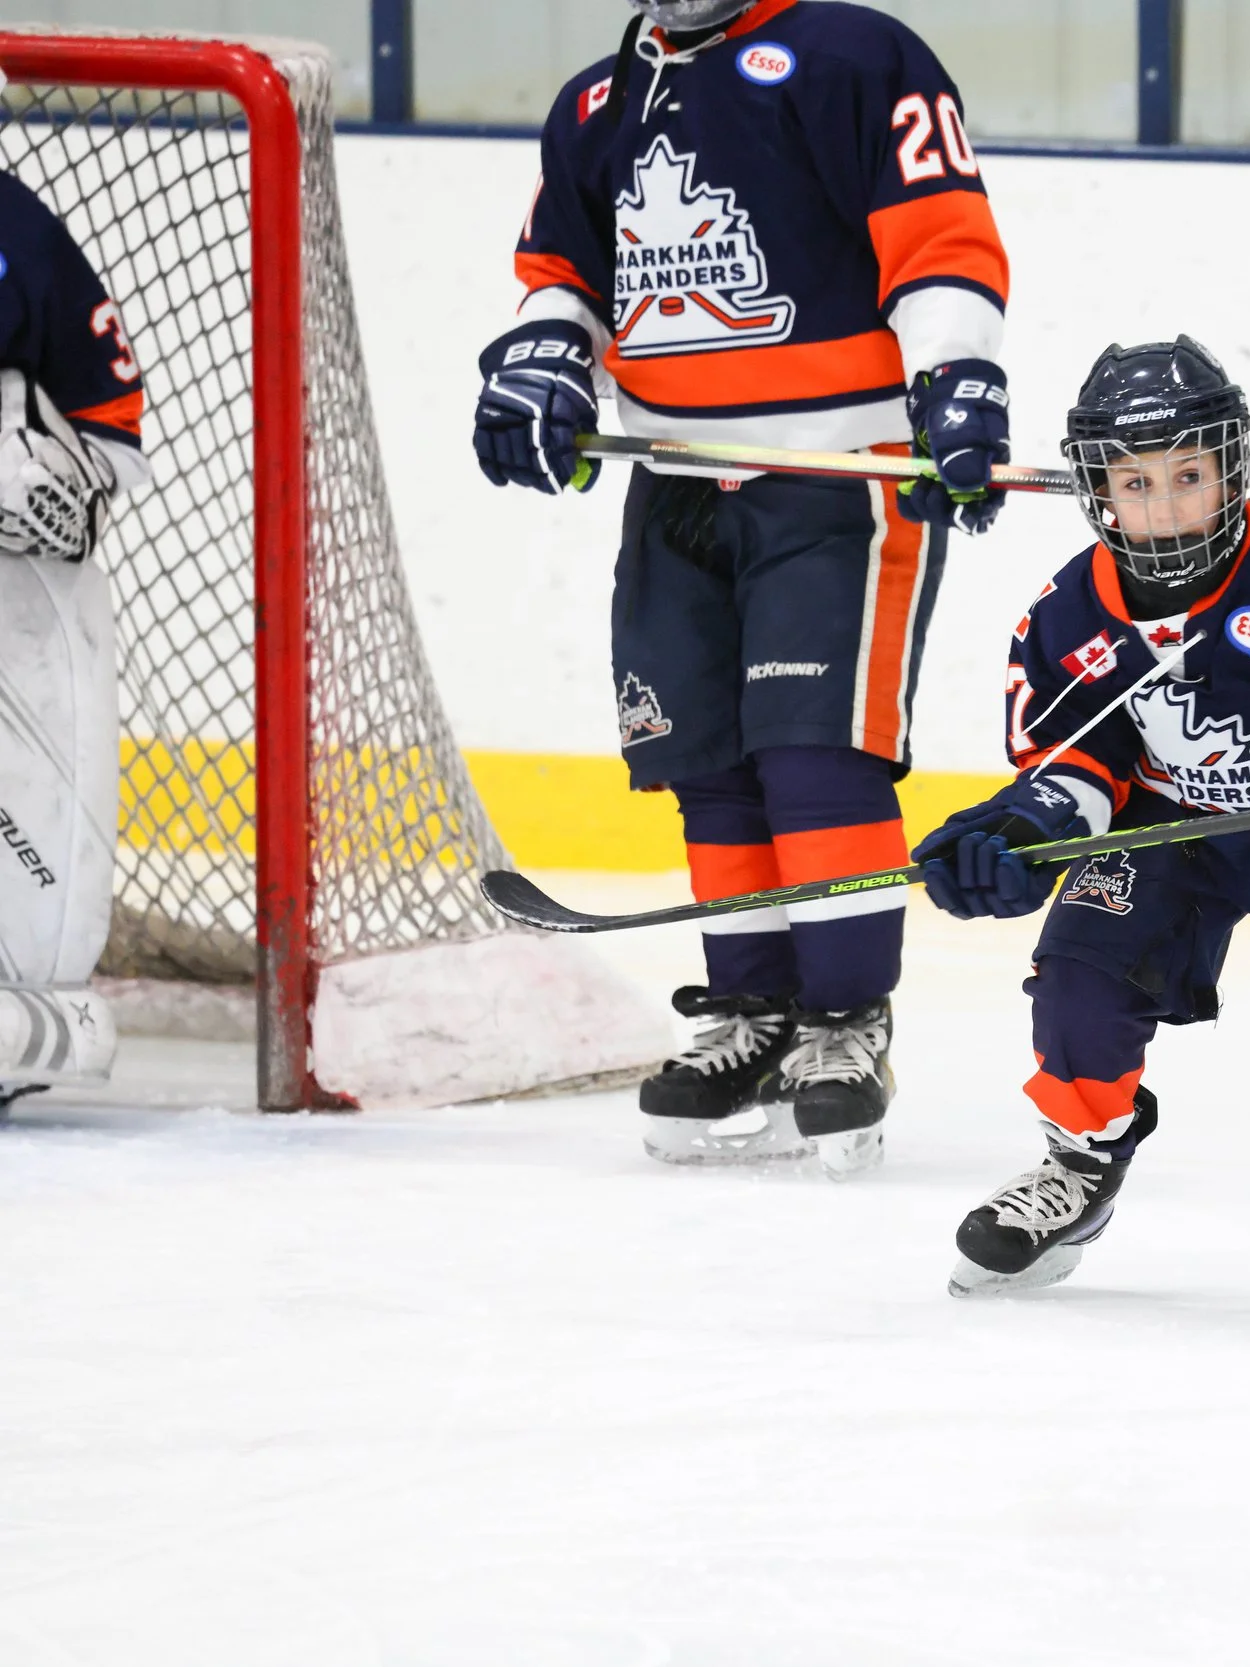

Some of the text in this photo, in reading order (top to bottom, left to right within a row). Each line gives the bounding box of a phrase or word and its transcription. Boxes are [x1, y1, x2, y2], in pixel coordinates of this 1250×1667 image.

[891, 92, 980, 187] 20
[616, 263, 746, 293] SLANDERS
[1114, 408, 1177, 426] BAUER
[1078, 880, 1123, 895] ISLANDERS
[1084, 872, 1125, 887] MARKHAM
